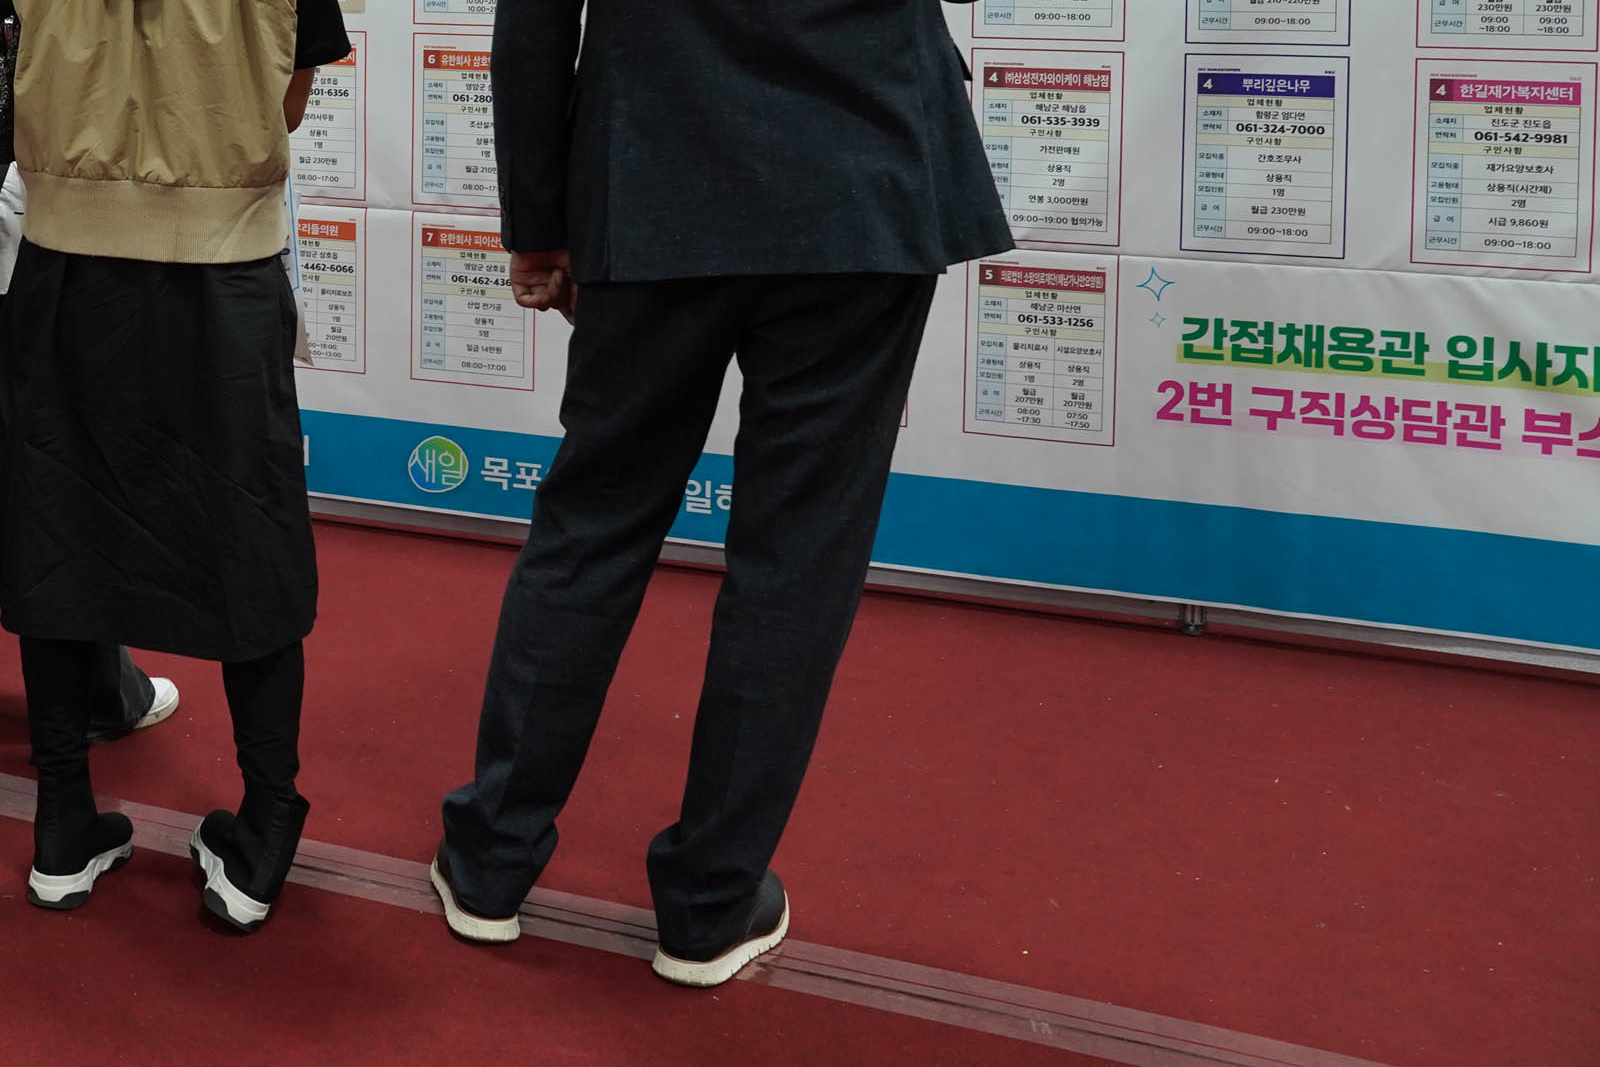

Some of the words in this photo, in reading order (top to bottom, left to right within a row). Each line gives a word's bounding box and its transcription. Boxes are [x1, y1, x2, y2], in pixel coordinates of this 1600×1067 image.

[428, 55, 435, 64] 6
[441, 55, 471, 66] 유한회사
[989, 72, 999, 82] 4
[1083, 75, 1109, 87] 해남점
[1203, 79, 1212, 89] 4
[1243, 78, 1311, 93] 뿌리깊은나무
[1436, 85, 1446, 95] 4
[1460, 84, 1573, 101] 한길재가복지센터
[1021, 115, 1100, 127] 061-535-3939
[1236, 123, 1325, 135] 061-324-7000
[1474, 131, 1568, 144] 061-542-9981
[1040, 146, 1080, 155] 가전판매원
[426, 234, 432, 242] 7
[440, 234, 472, 246] 유한회사
[1484, 238, 1551, 250] 09:00~18:00
[985, 270, 992, 280] 5
[1018, 314, 1094, 327] 061-533-1256
[1181, 316, 1430, 377] 간접채용관
[1156, 380, 1233, 427] 2번
[1249, 386, 1507, 450] 구직상담관
[409, 446, 467, 486] 새일
